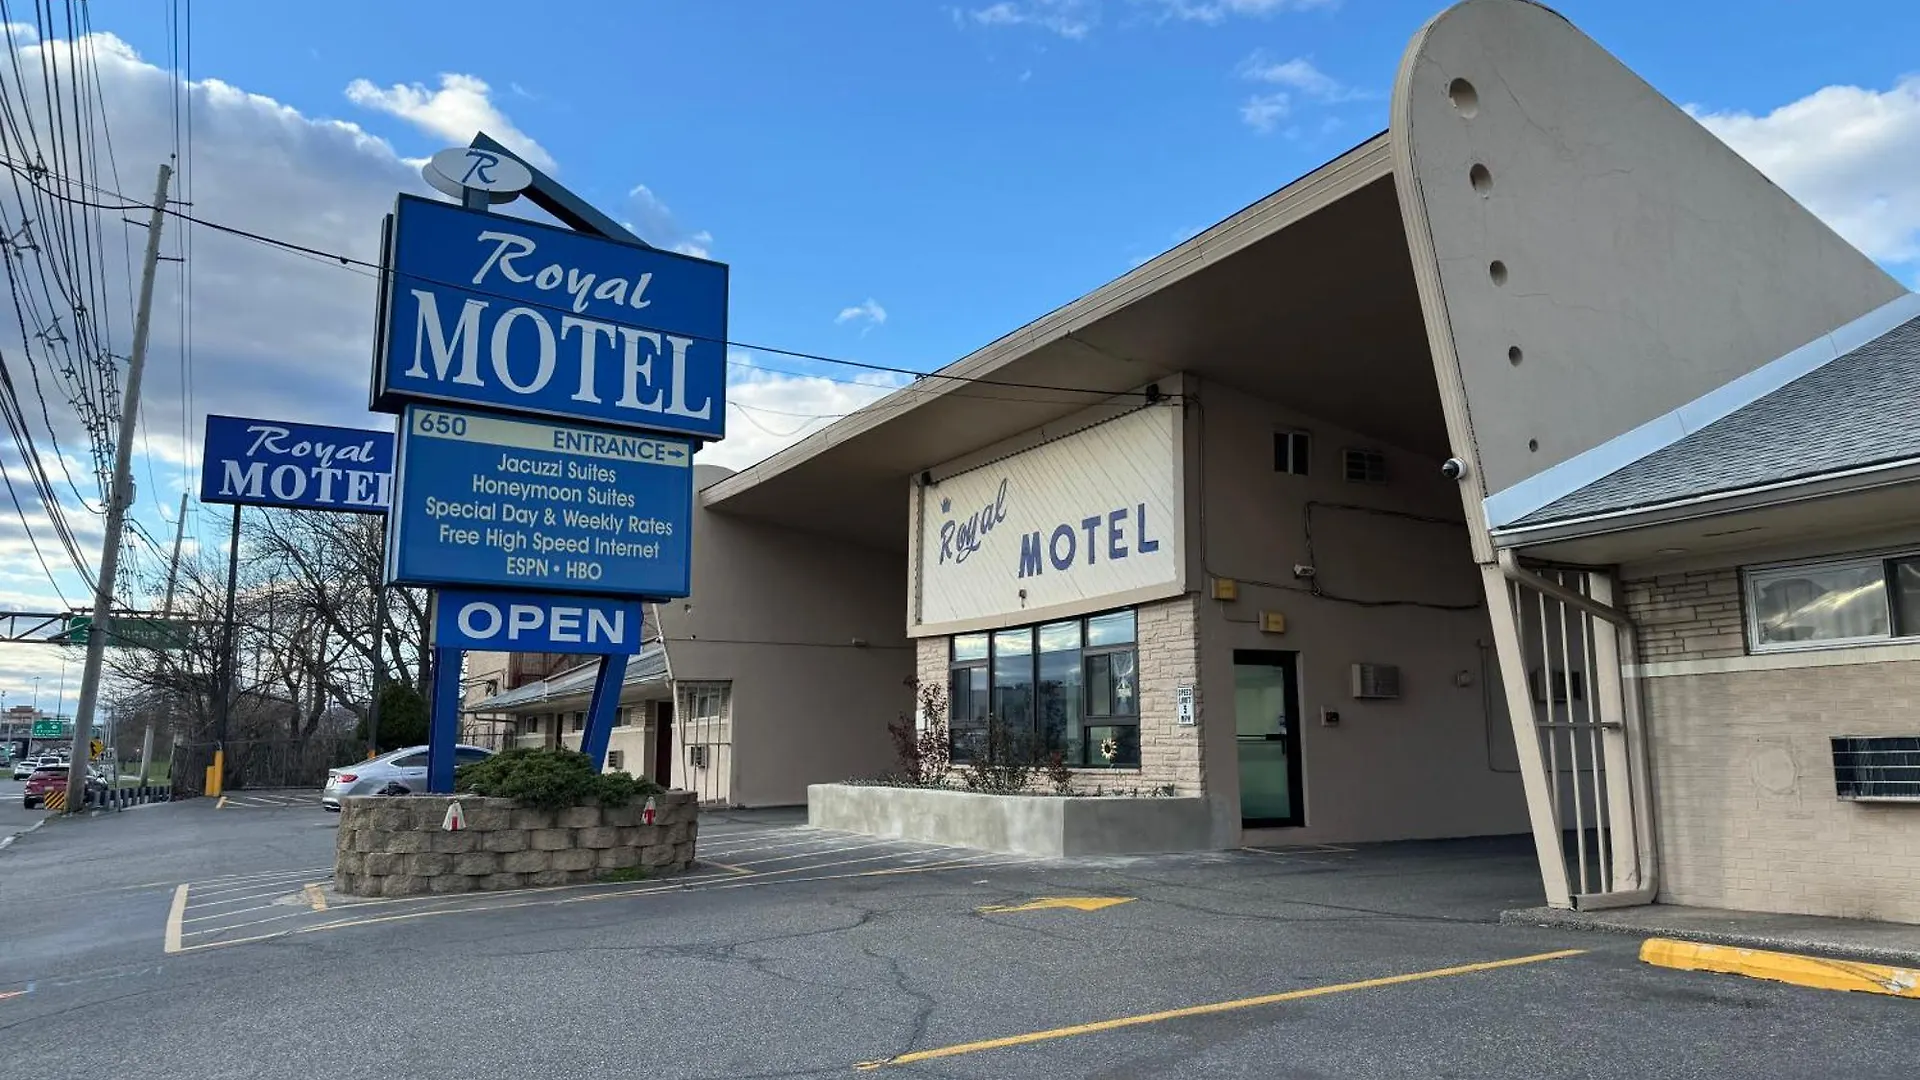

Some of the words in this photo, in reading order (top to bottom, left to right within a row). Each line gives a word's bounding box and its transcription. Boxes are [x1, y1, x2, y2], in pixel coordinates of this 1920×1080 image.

[461, 151, 499, 184] R
[472, 231, 652, 313] Royal
[405, 289, 711, 420] MOTEL
[246, 426, 375, 468] Royal
[419, 413, 467, 436] 650
[553, 431, 666, 461] ENTRANCE
[497, 454, 563, 477] Jacuzzi
[568, 461, 617, 483] Suites
[472, 474, 582, 502] Honeymoon
[587, 486, 636, 508] Suites
[425, 496, 496, 519] Special
[502, 504, 539, 527] Day
[543, 508, 557, 525] &
[563, 510, 624, 535] Weekly
[628, 516, 673, 535] Rates
[939, 477, 1007, 565] Royal
[439, 524, 480, 545] Free
[486, 529, 527, 552] High
[532, 532, 590, 554] Speed
[595, 538, 660, 558] Internet
[1018, 503, 1159, 578] MOTEL
[506, 557, 548, 577] ESPN
[566, 562, 602, 580] HBO
[457, 602, 624, 644] OPEN
